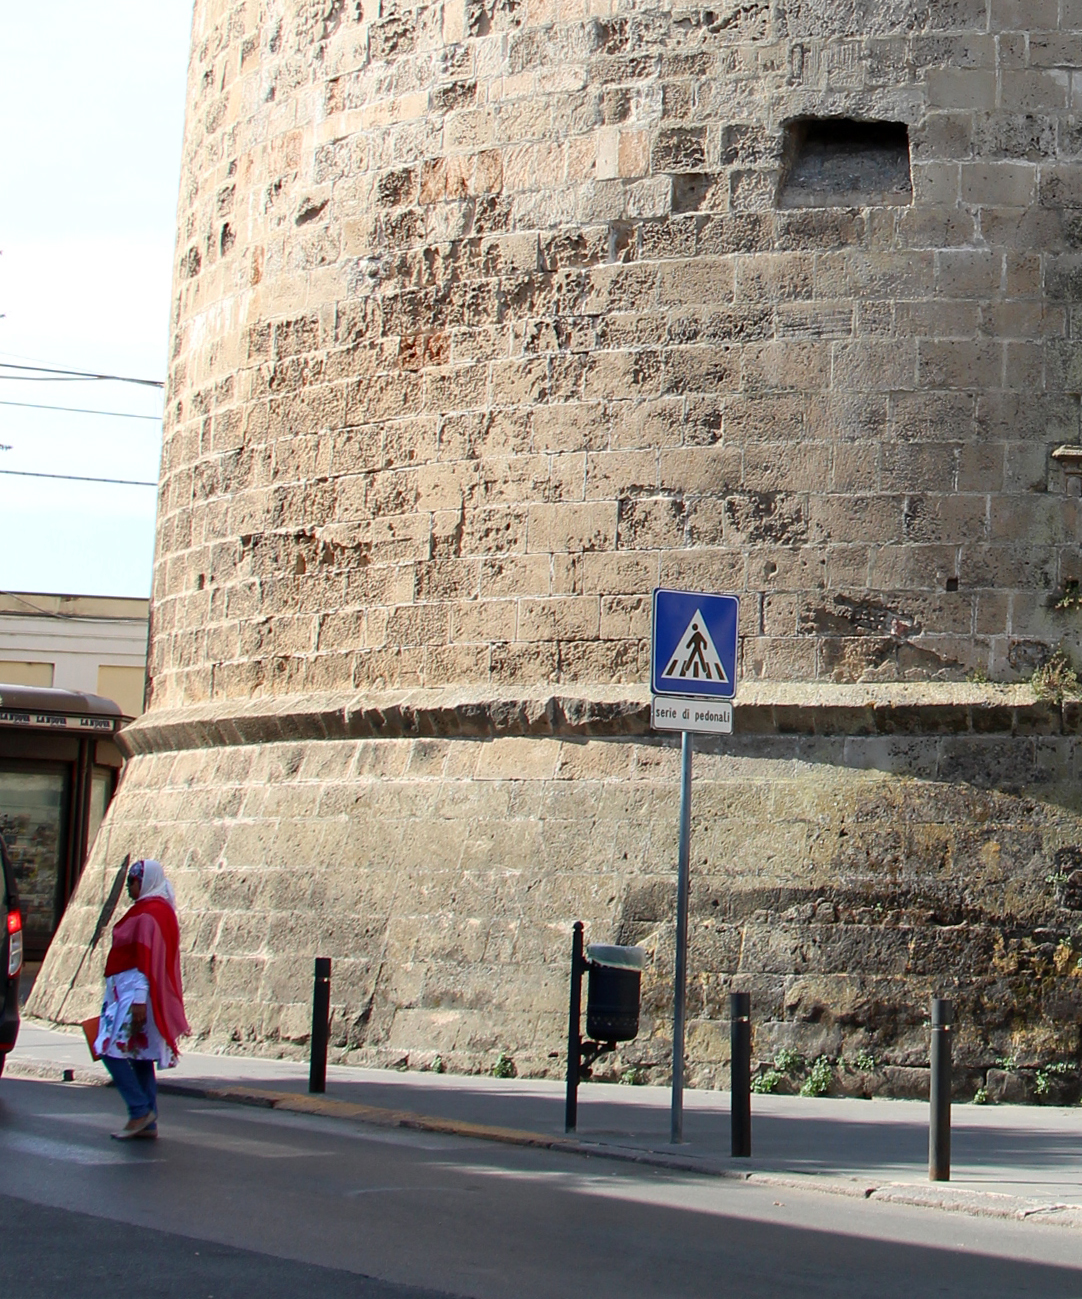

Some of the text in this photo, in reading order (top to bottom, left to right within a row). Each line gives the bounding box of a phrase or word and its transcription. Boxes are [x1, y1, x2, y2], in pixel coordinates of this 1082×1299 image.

[656, 708, 730, 723] serie di pedonali
